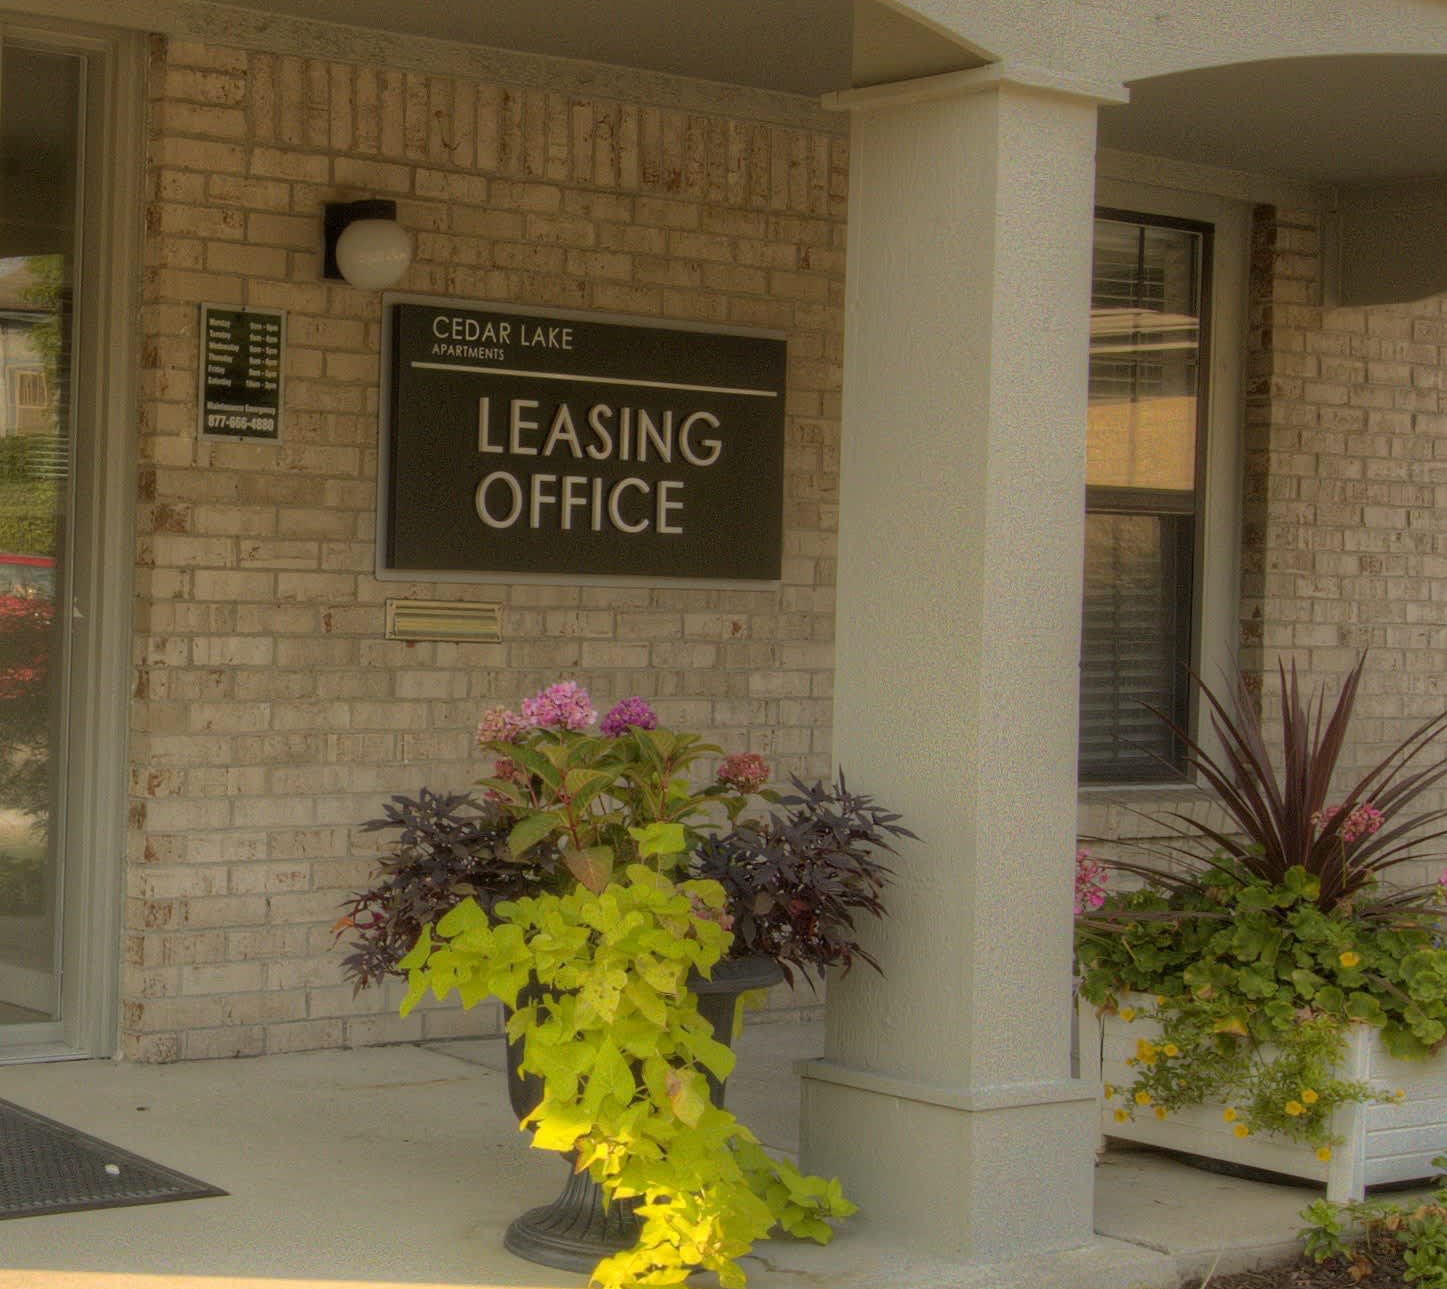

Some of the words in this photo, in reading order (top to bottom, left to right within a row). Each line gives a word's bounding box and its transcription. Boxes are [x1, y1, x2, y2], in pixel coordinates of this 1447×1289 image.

[432, 315, 511, 345] CEDAR
[520, 323, 574, 350] LAKE
[432, 343, 504, 361] APARTMENTS
[478, 396, 723, 467] LEASING
[475, 470, 685, 535] OFFICE
